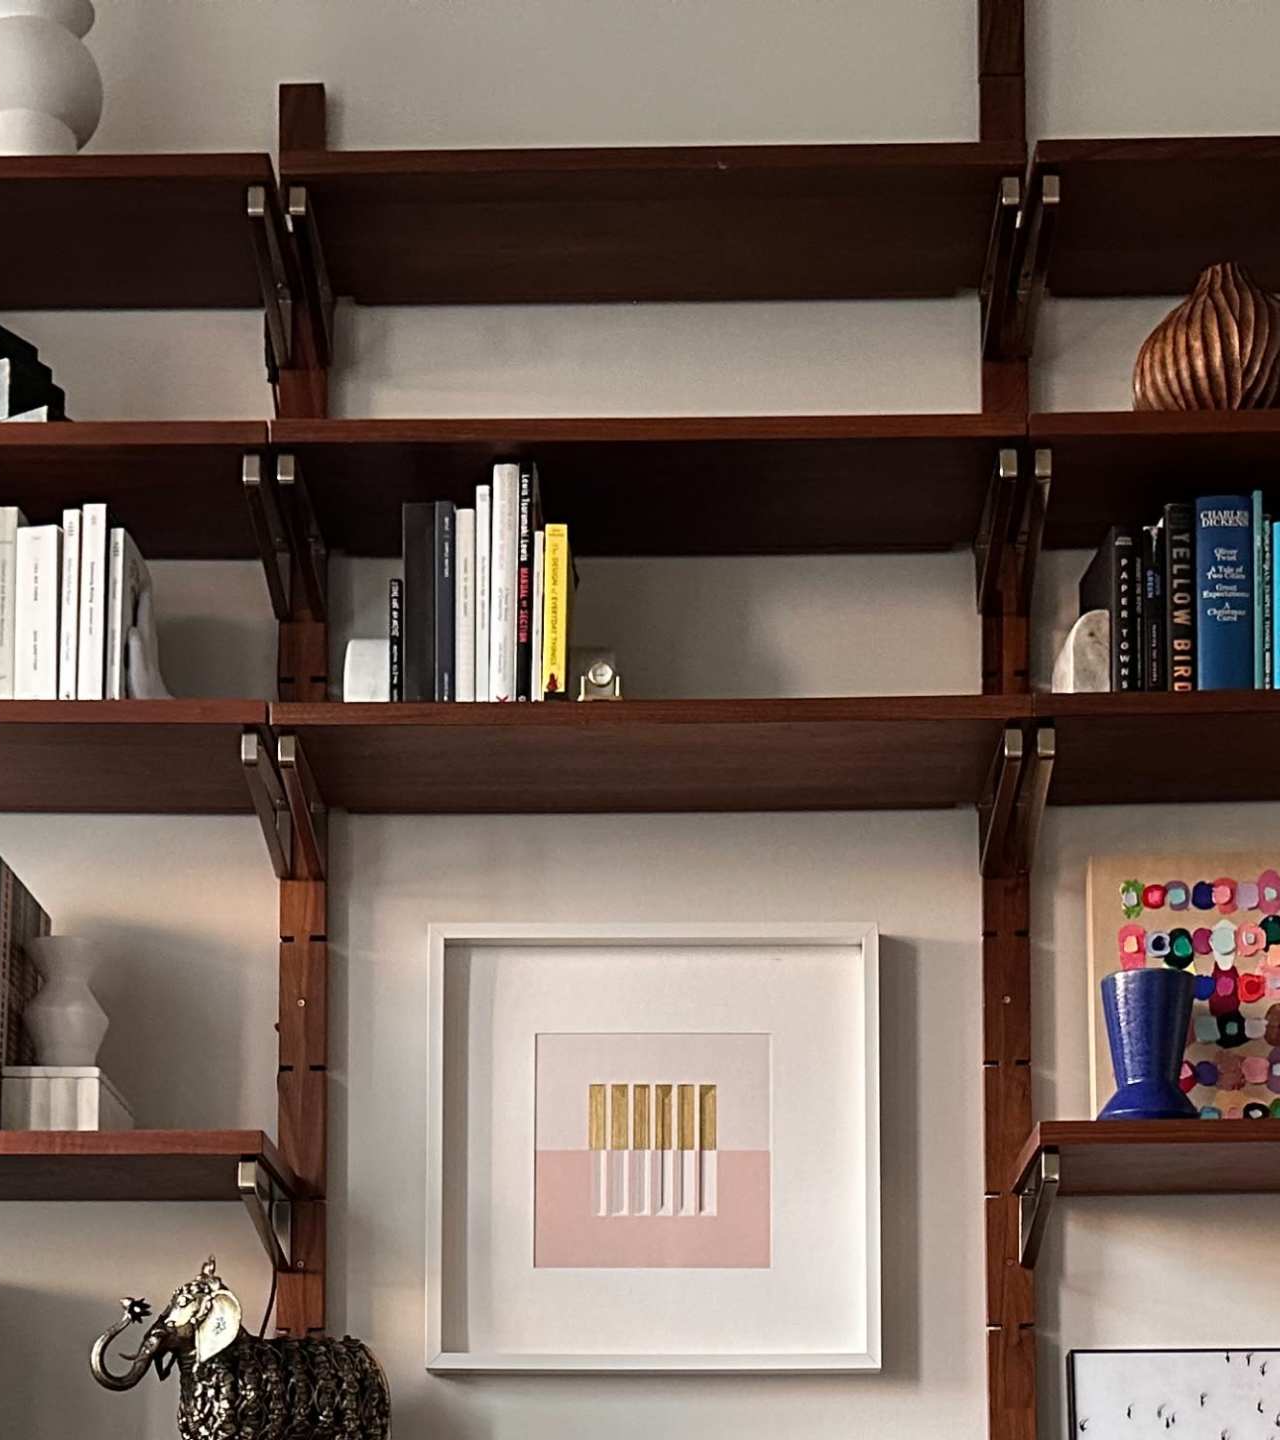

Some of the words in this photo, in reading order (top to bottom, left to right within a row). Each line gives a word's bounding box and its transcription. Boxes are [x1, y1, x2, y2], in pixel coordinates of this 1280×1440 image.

[1200, 510, 1249, 520] CHARLES
[1202, 518, 1249, 528] DICKENS
[1172, 533, 1192, 625] YELLOW
[1120, 629, 1130, 689] TOWNS
[1173, 639, 1191, 691] BIRD
